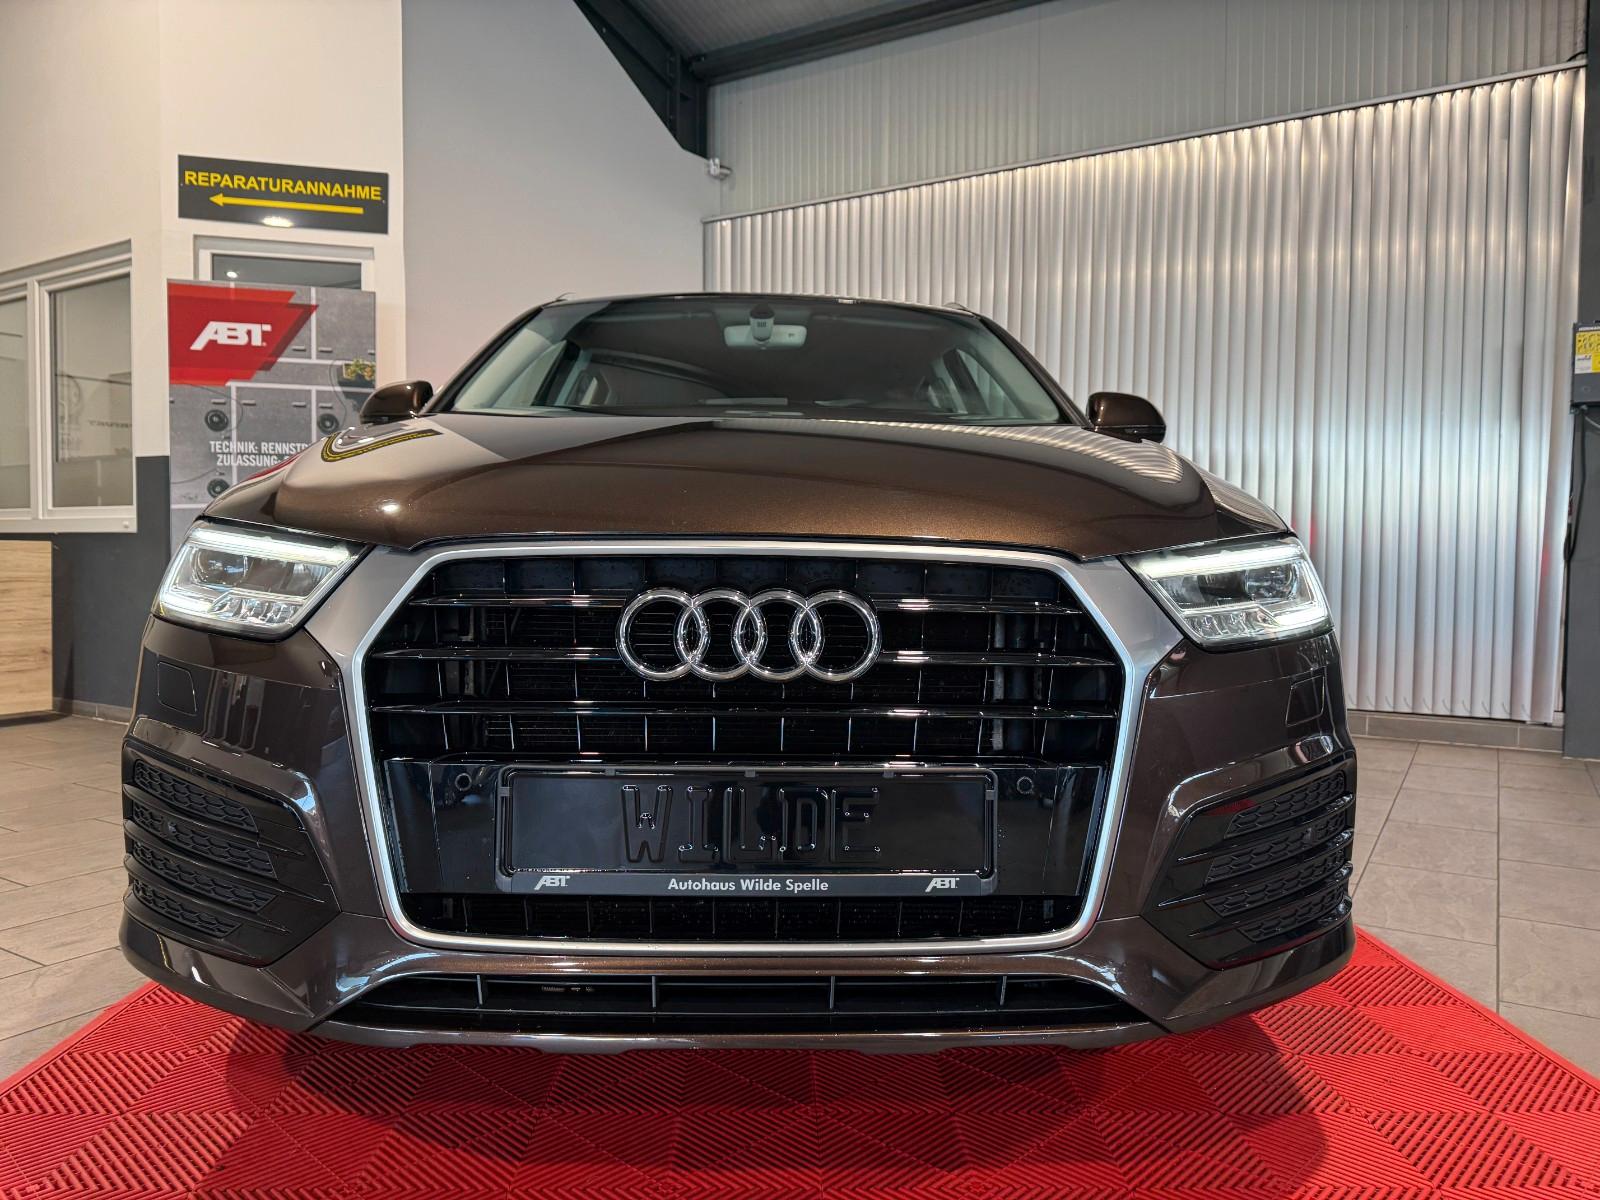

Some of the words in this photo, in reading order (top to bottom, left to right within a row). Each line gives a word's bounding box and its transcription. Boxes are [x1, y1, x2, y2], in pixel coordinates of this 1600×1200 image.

[184, 170, 382, 201] REPARATURANNAHME
[190, 321, 272, 351] ABT
[209, 441, 258, 453] TECHNIK:
[261, 442, 312, 455] RENNST
[621, 785, 880, 863] WILDE
[534, 875, 571, 890] ABT
[667, 878, 736, 890] Autohaus
[740, 878, 781, 891] Wilde
[785, 879, 829, 893] Spelle
[925, 877, 960, 892] ABT
